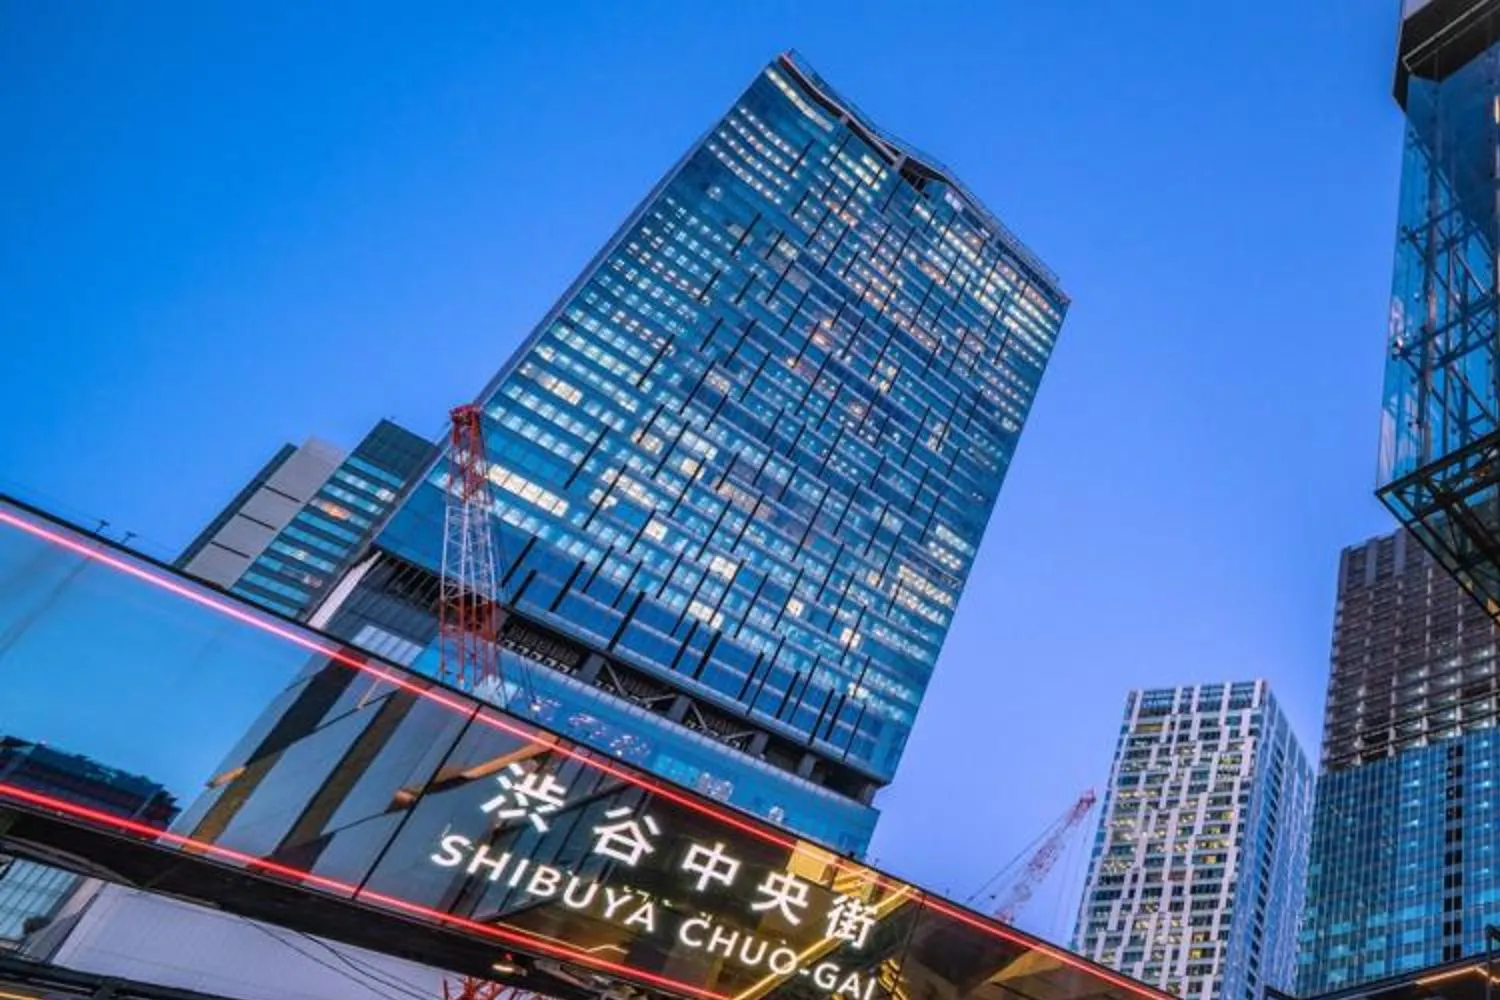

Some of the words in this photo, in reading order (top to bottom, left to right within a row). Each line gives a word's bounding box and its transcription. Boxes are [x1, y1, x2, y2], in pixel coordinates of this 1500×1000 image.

[429, 834, 656, 934] SHIBUYA
[480, 762, 878, 952] 渋谷中央街
